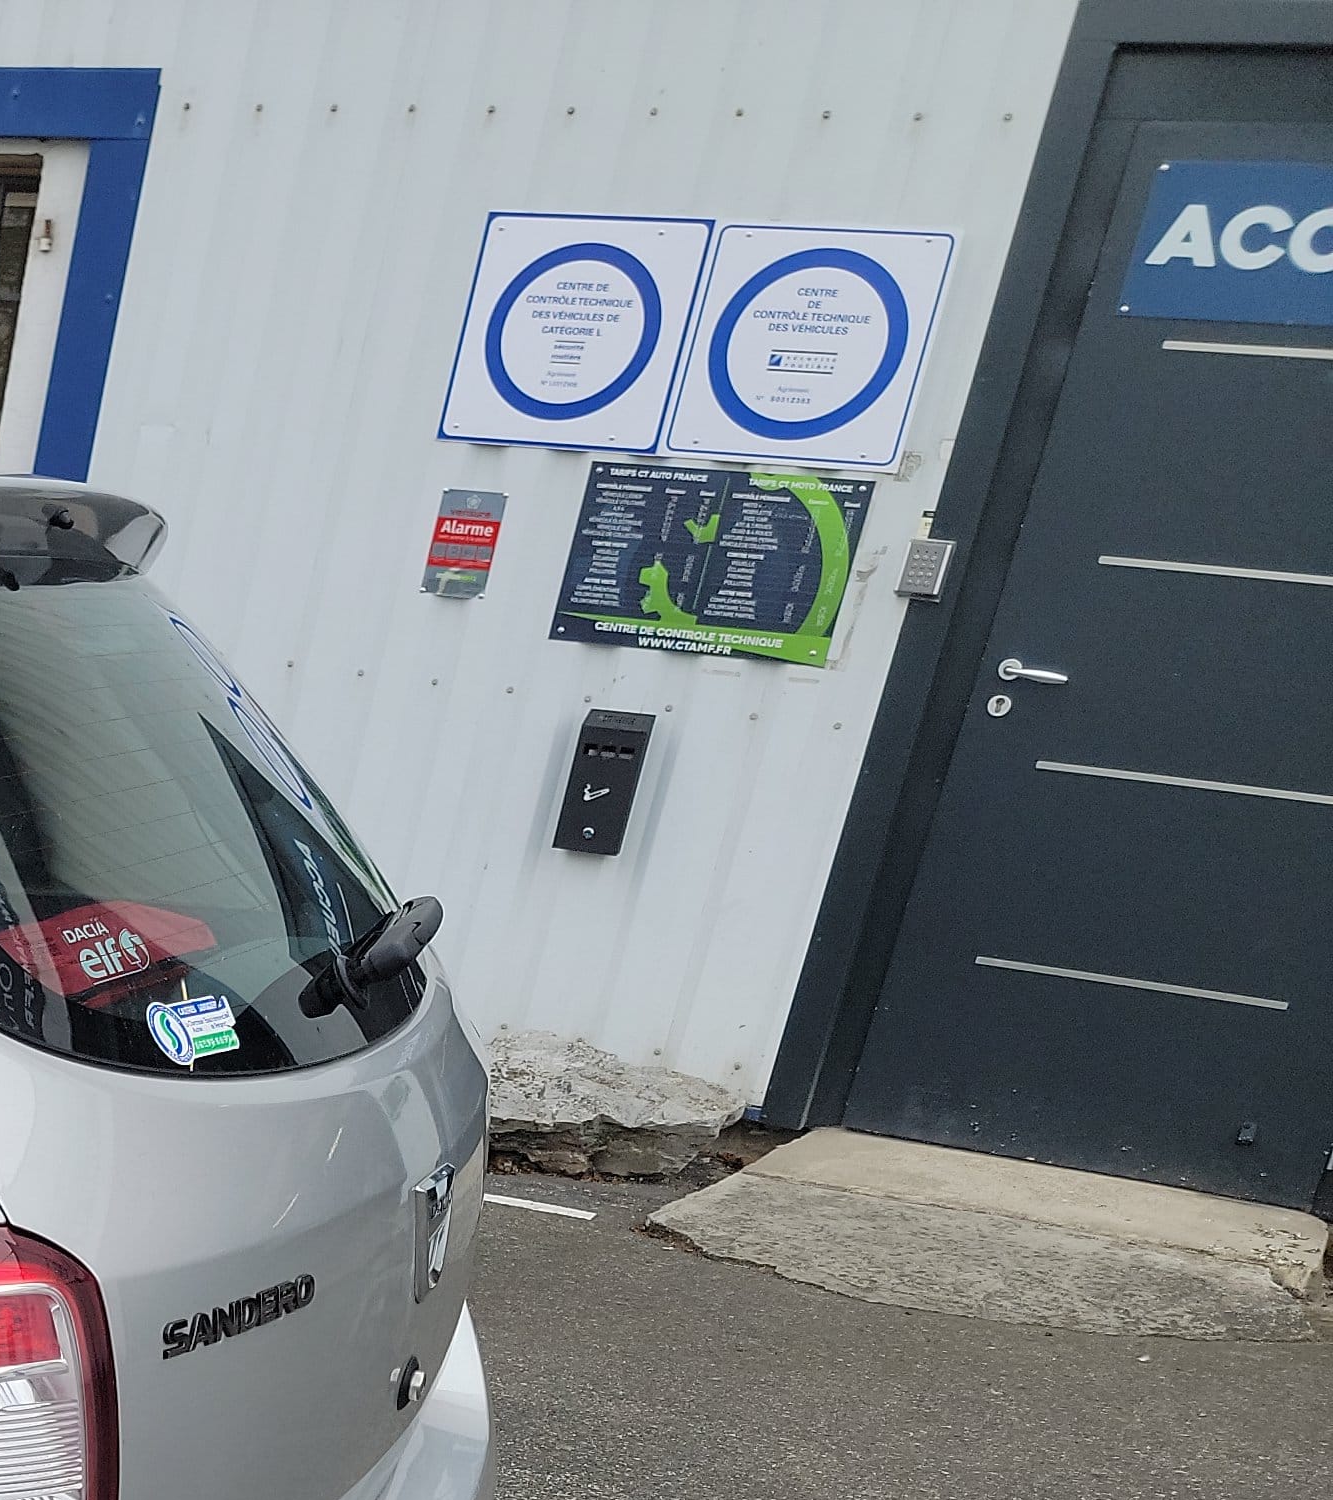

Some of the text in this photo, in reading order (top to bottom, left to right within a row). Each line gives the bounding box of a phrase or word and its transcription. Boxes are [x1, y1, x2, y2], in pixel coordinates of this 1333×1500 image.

[556, 281, 610, 292] CENTRE DE
[797, 288, 838, 298] CENTRE
[578, 297, 634, 308] TECHNIQUE
[807, 300, 822, 309] DE
[532, 310, 620, 322] DES VÉHICULES DE
[753, 310, 872, 324] CONTRÔLE TECHNIQUE
[768, 323, 849, 336] DES VÉHICULES
[649, 471, 673, 480] AUTO
[673, 472, 709, 482] FRANCE
[790, 481, 816, 490] MOTO
[818, 483, 854, 493] FRANCE
[440, 520, 494, 537] Alarme
[594, 621, 784, 649] CENTRE DE CONTROLE TECHNIQUE
[638, 636, 732, 656] WWW.CTAMF.FR
[62, 920, 110, 944] DACIA
[79, 937, 125, 978] elf
[162, 1273, 316, 1360] SANDERO
